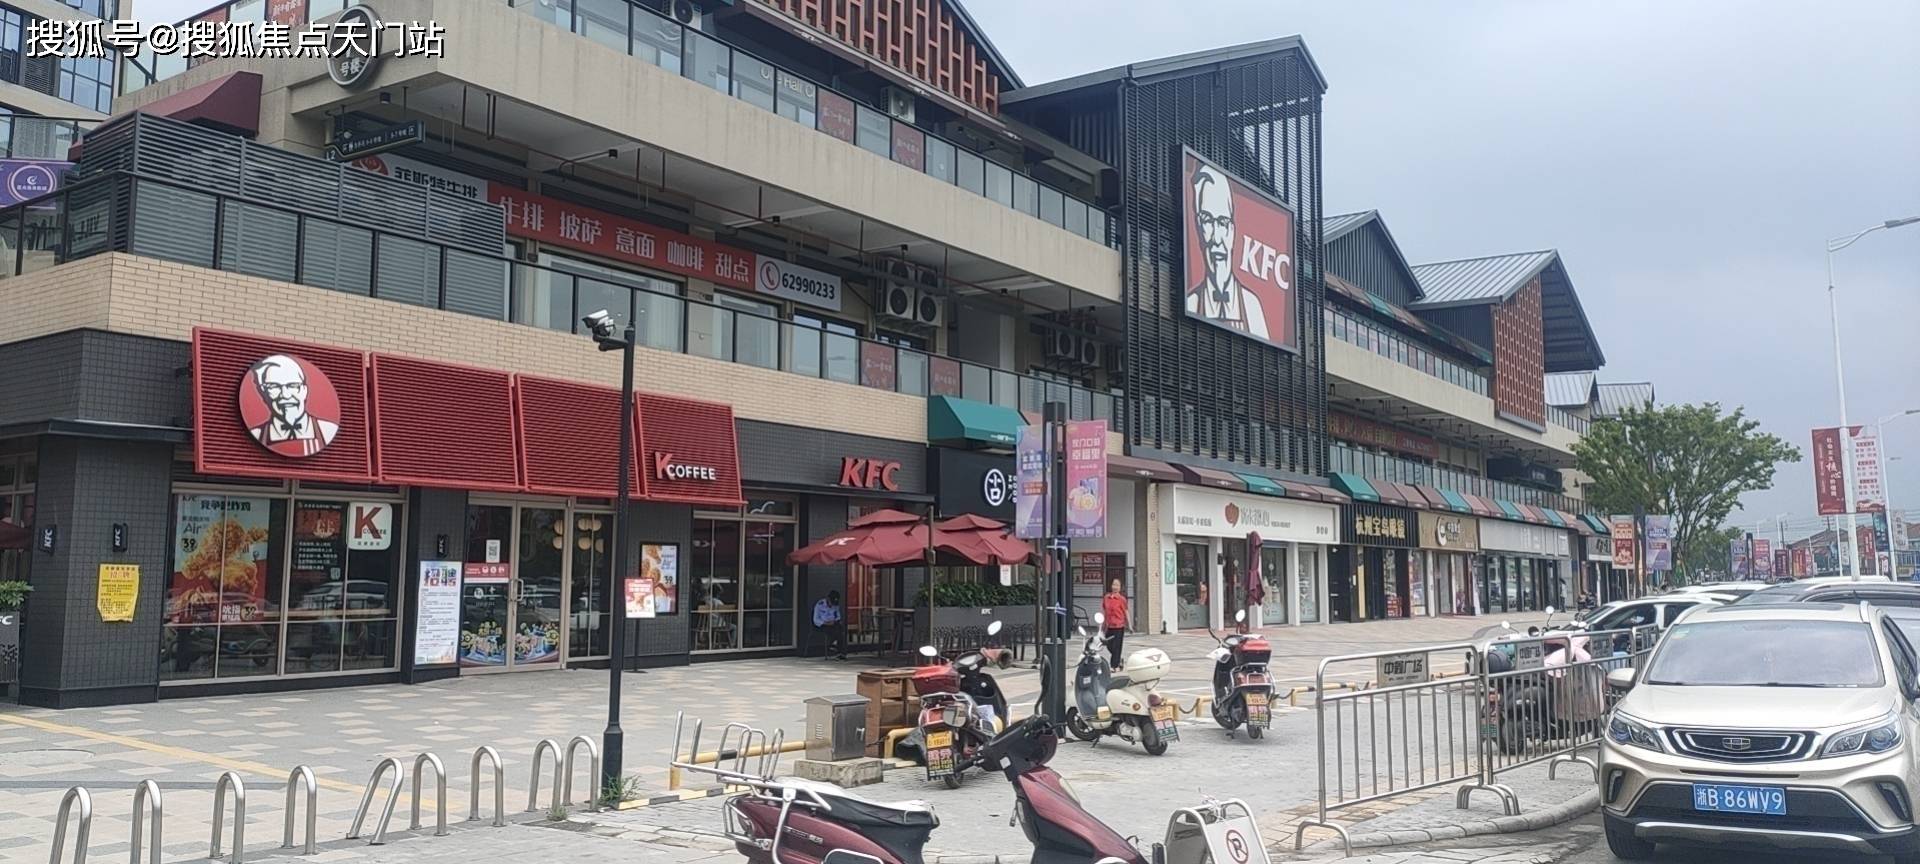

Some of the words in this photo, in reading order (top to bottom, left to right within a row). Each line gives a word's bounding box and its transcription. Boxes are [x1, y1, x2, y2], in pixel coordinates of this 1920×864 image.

[340, 57, 363, 76] 号楼
[501, 196, 544, 232] 牛排
[560, 211, 602, 245] 披萨
[615, 226, 655, 260] 意面
[667, 240, 704, 272] 咖啡
[715, 252, 749, 282] 甜点
[1240, 234, 1290, 290] KFC
[782, 272, 835, 300] 62990233
[840, 456, 901, 491] KFC
[44, 528, 53, 548] KFC
